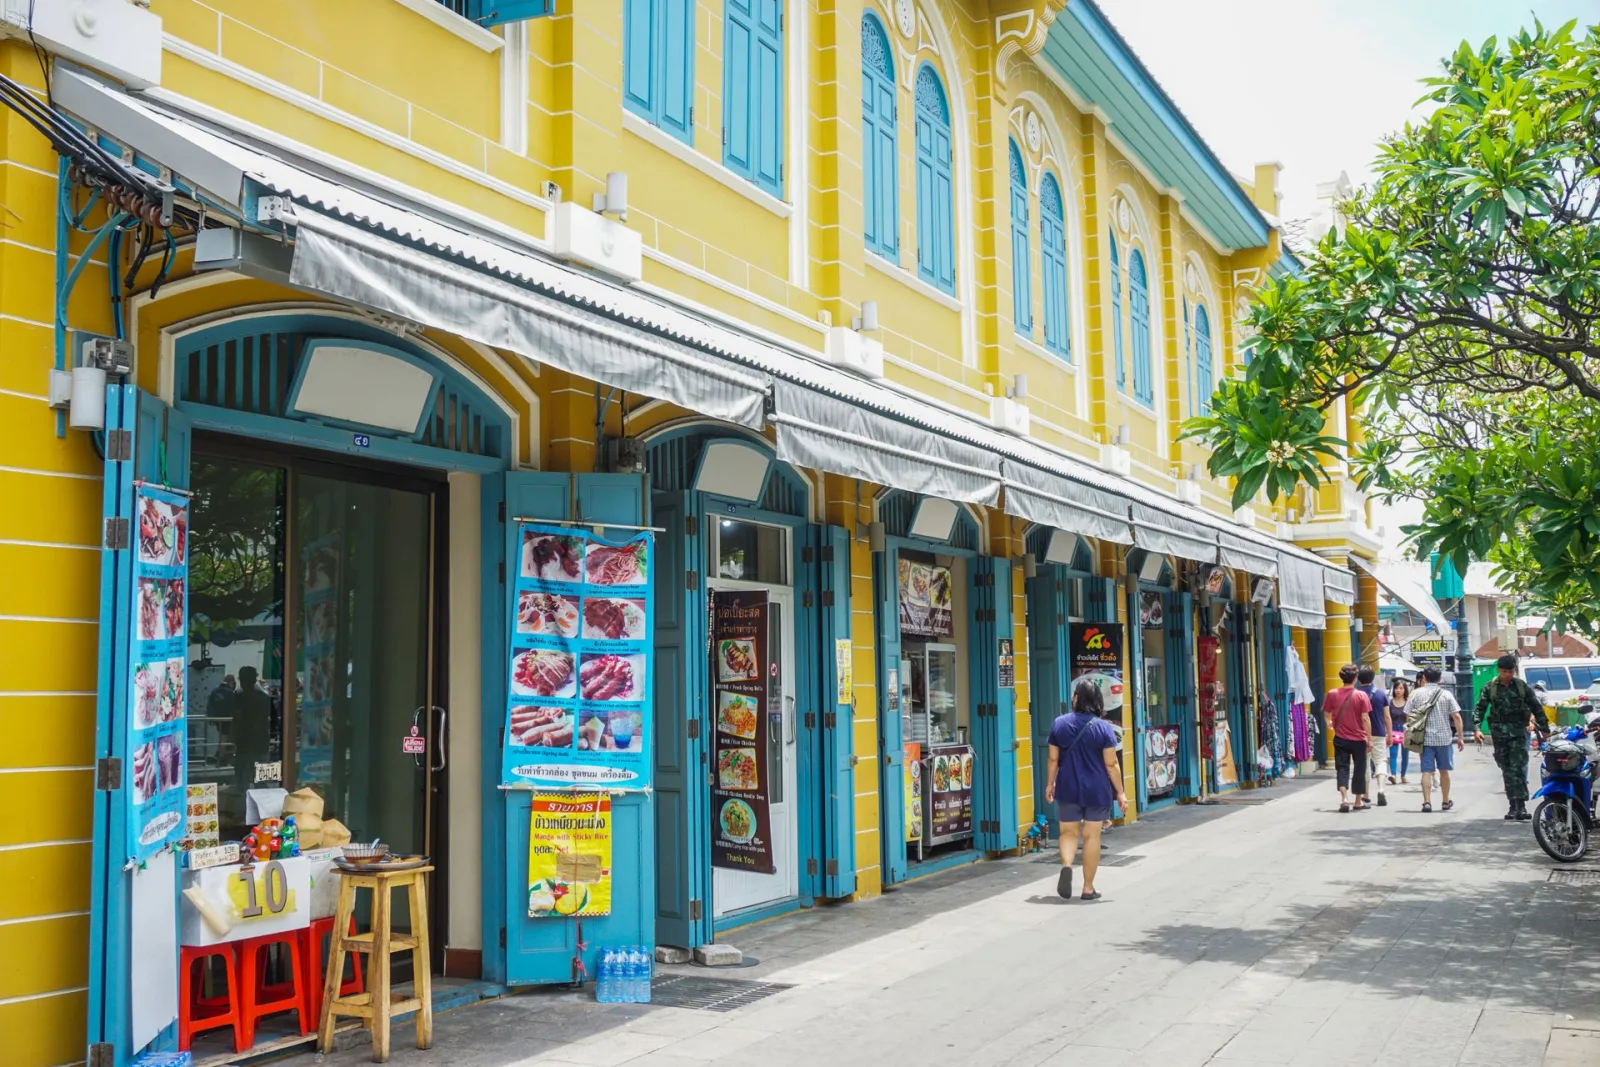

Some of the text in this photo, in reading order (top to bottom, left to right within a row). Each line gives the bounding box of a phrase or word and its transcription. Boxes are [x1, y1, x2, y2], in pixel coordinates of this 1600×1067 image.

[517, 764, 632, 780] รับทำข้าวกล่อง ชุดขนม เครื่องดื่ม
[547, 802, 594, 812] รายการ
[534, 814, 606, 830] ข้าวเหนียวมะม่วง
[534, 833, 555, 842] Mango
[556, 833, 571, 841] with
[573, 833, 592, 841] Sticky
[726, 853, 755, 864] Thank You
[239, 860, 288, 918] 10
